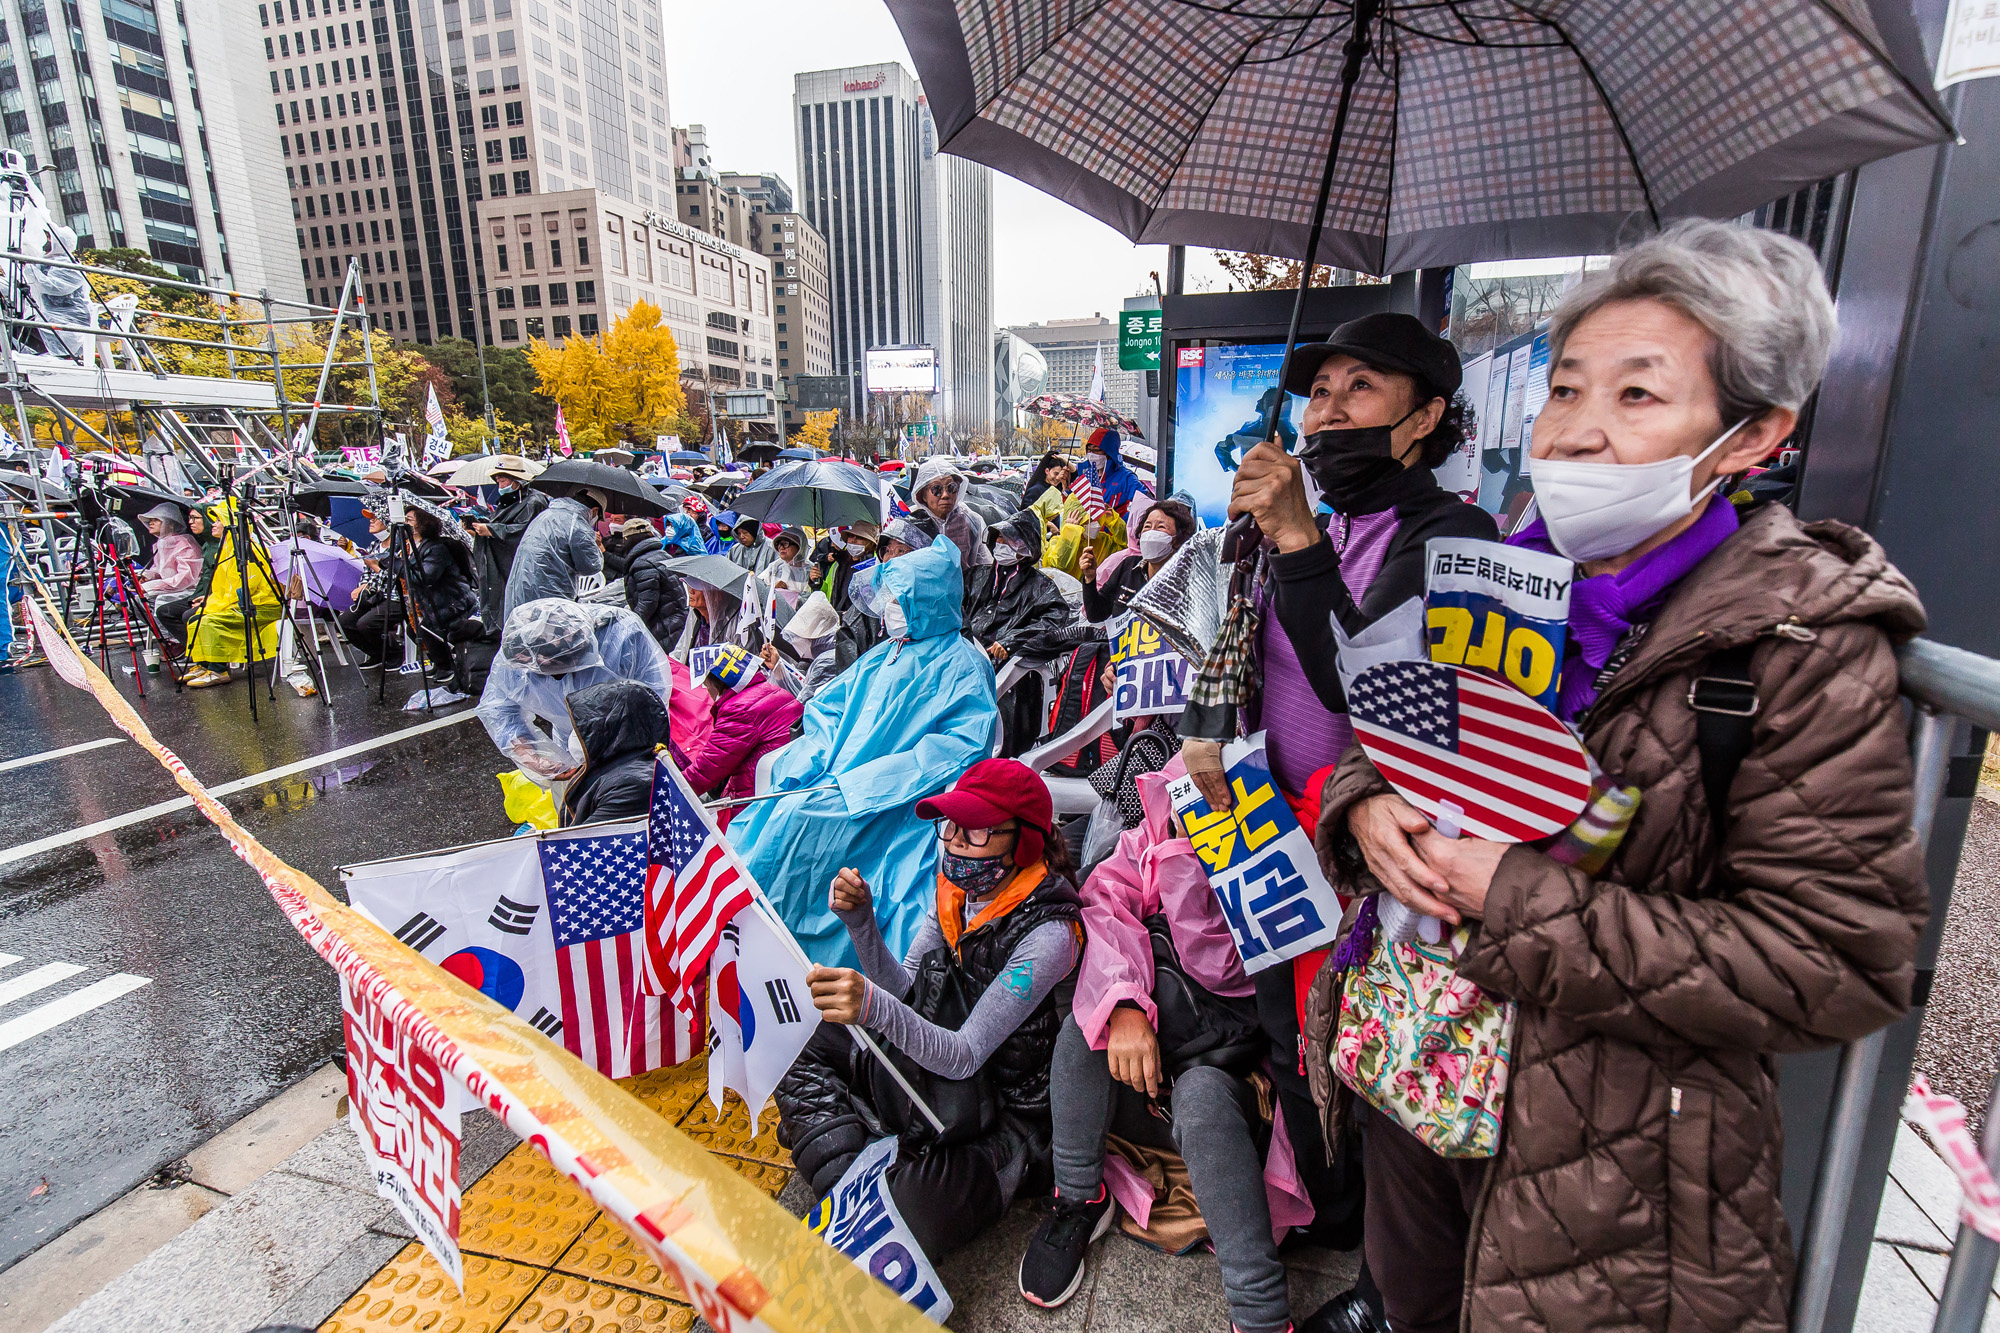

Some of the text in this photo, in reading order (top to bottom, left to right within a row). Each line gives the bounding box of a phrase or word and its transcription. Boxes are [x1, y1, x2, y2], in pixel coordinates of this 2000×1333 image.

[843, 80, 880, 93] kobaco
[922, 106, 933, 160] 서울신문
[662, 216, 690, 239] SEOUL
[689, 227, 720, 251] FINANCE
[719, 240, 743, 259] CENTER
[1125, 316, 1162, 335] 종로
[1125, 336, 1152, 349] Jongno
[1180, 349, 1203, 361] RSC
[429, 437, 449, 456] 경산
[1182, 775, 1280, 873] 구속
[350, 1022, 461, 1233] 구속하라
